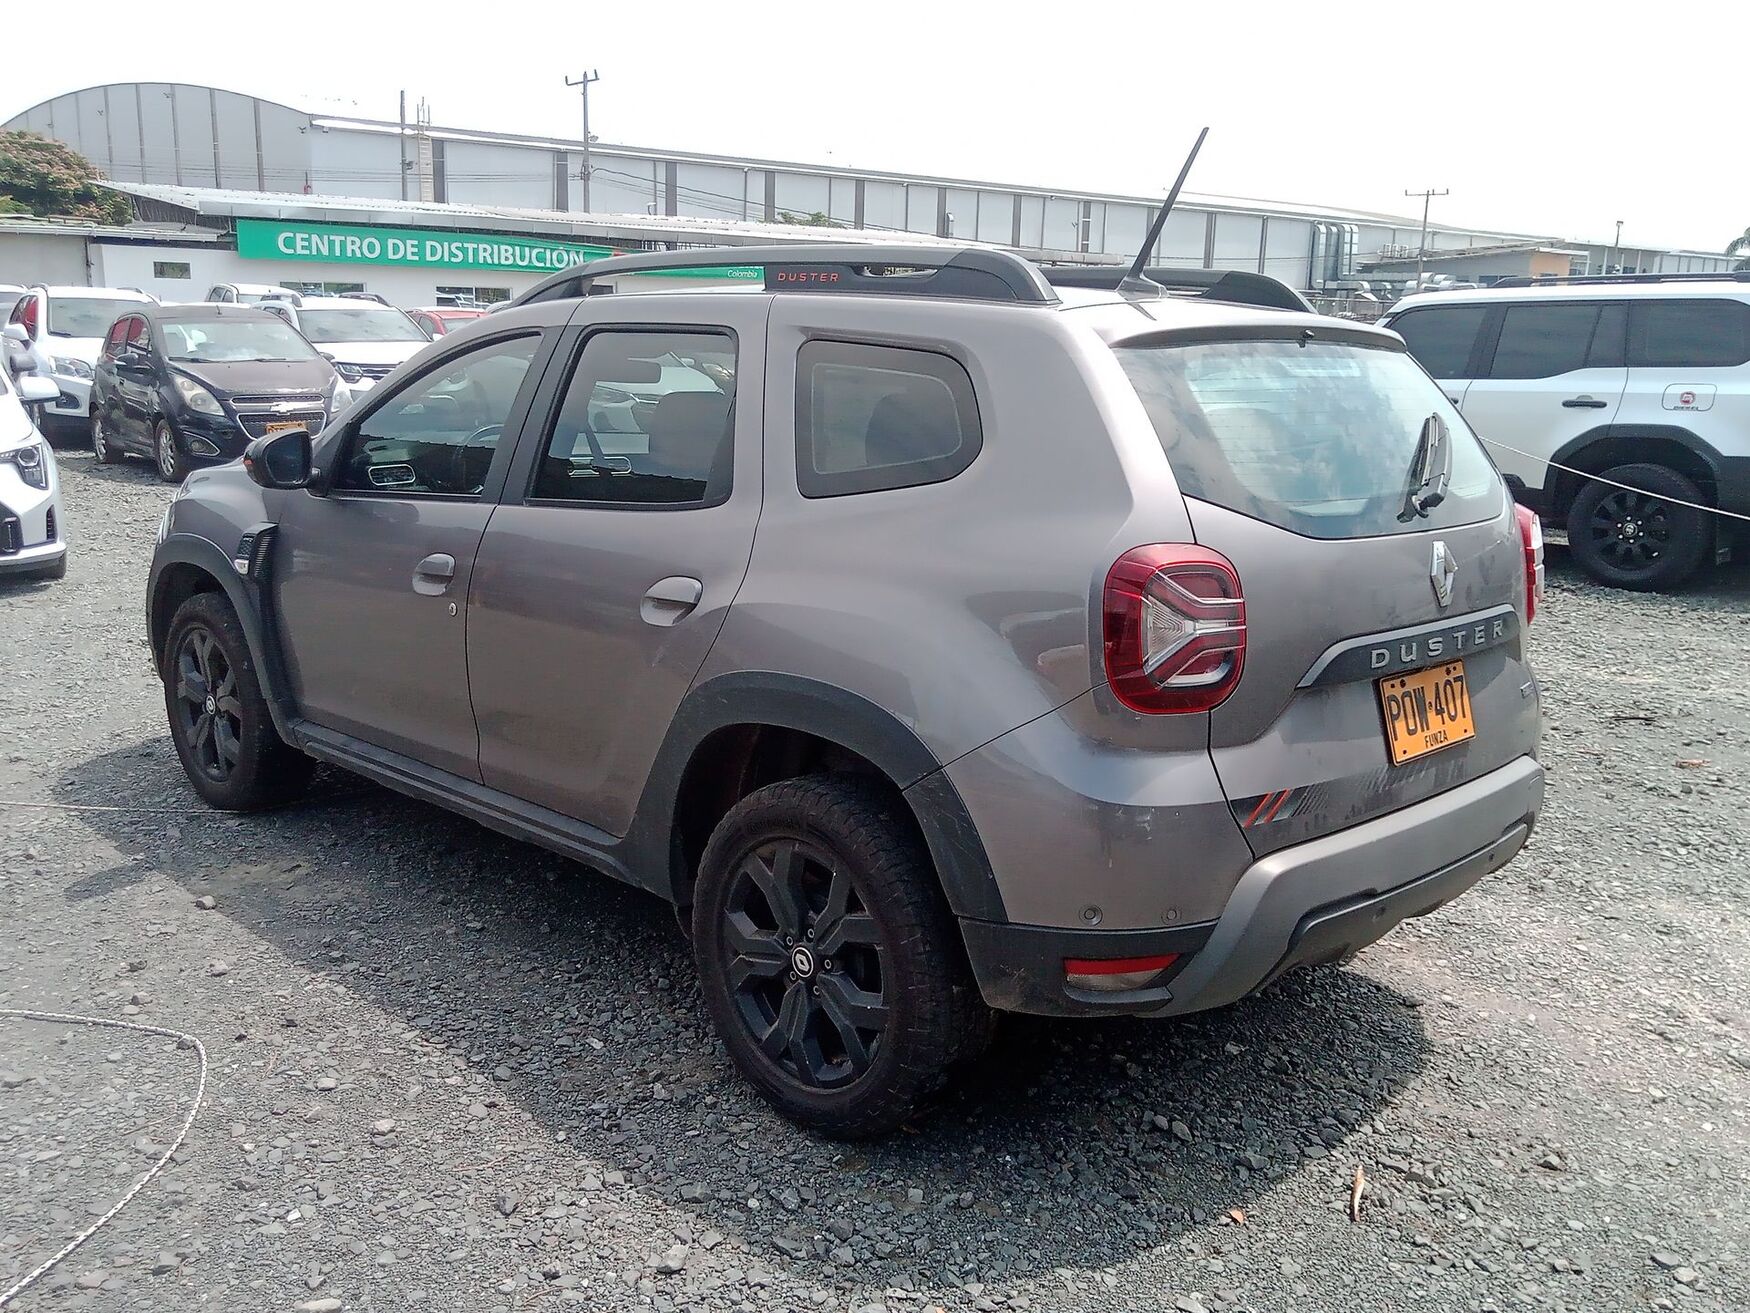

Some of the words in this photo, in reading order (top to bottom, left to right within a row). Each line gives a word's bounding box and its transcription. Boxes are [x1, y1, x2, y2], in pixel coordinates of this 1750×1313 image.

[277, 232, 381, 259] CENTRO
[387, 238, 419, 261] DE
[425, 240, 585, 268] DISTRIBUCIÓN
[727, 269, 758, 278] Colombia
[777, 272, 840, 282] DUSTER
[1371, 620, 1503, 668] DUSTER
[1424, 729, 1449, 749] FUNZA
